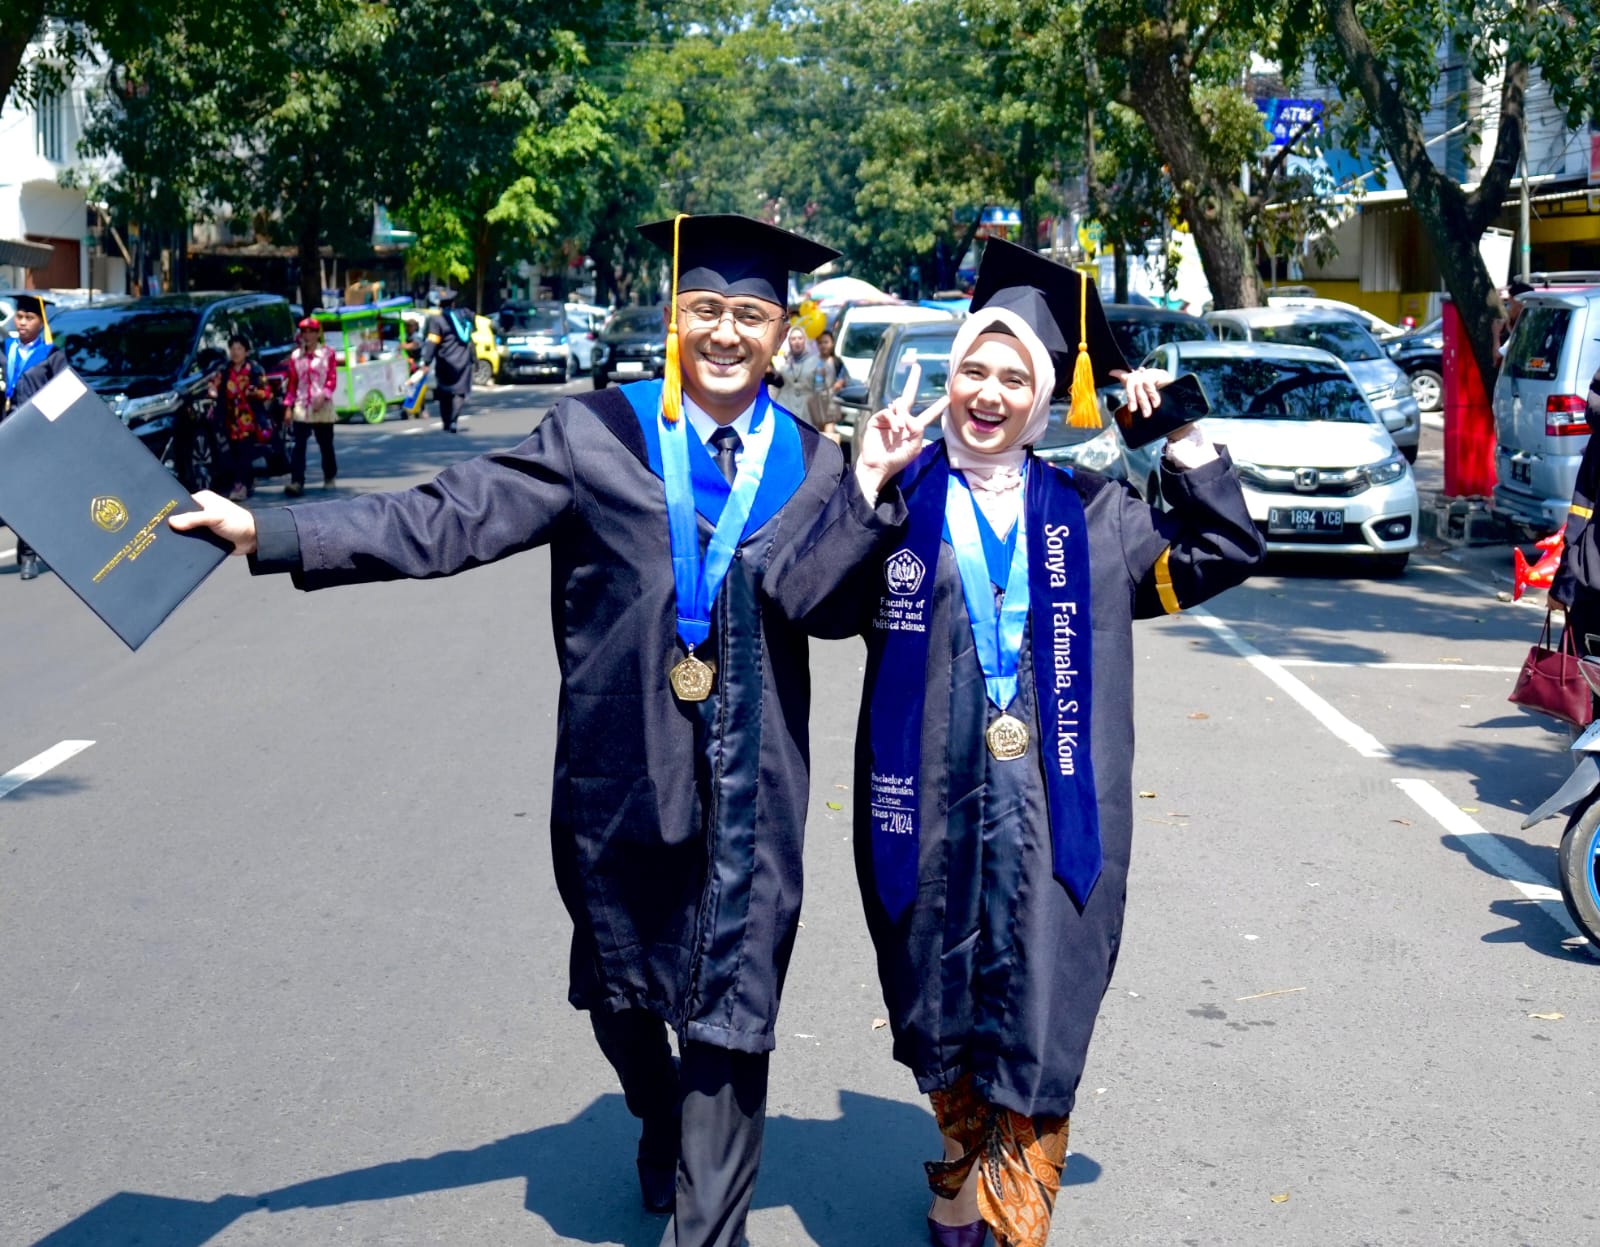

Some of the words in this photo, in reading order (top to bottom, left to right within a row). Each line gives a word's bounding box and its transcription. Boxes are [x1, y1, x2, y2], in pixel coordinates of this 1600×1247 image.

[1271, 509, 1278, 523] D
[1291, 510, 1316, 524] 1894
[1322, 511, 1341, 525] YCB
[1045, 524, 1069, 587] Sonya
[880, 597, 913, 609] Faculty
[916, 600, 925, 608] of
[880, 608, 902, 618] Social
[905, 611, 922, 620] and
[873, 619, 899, 630] Political
[900, 621, 926, 632] Science
[1052, 602, 1078, 694] Fatmala,
[1058, 698, 1079, 776] S.I.Kom
[905, 776, 914, 785] of
[889, 811, 913, 835] 2024
